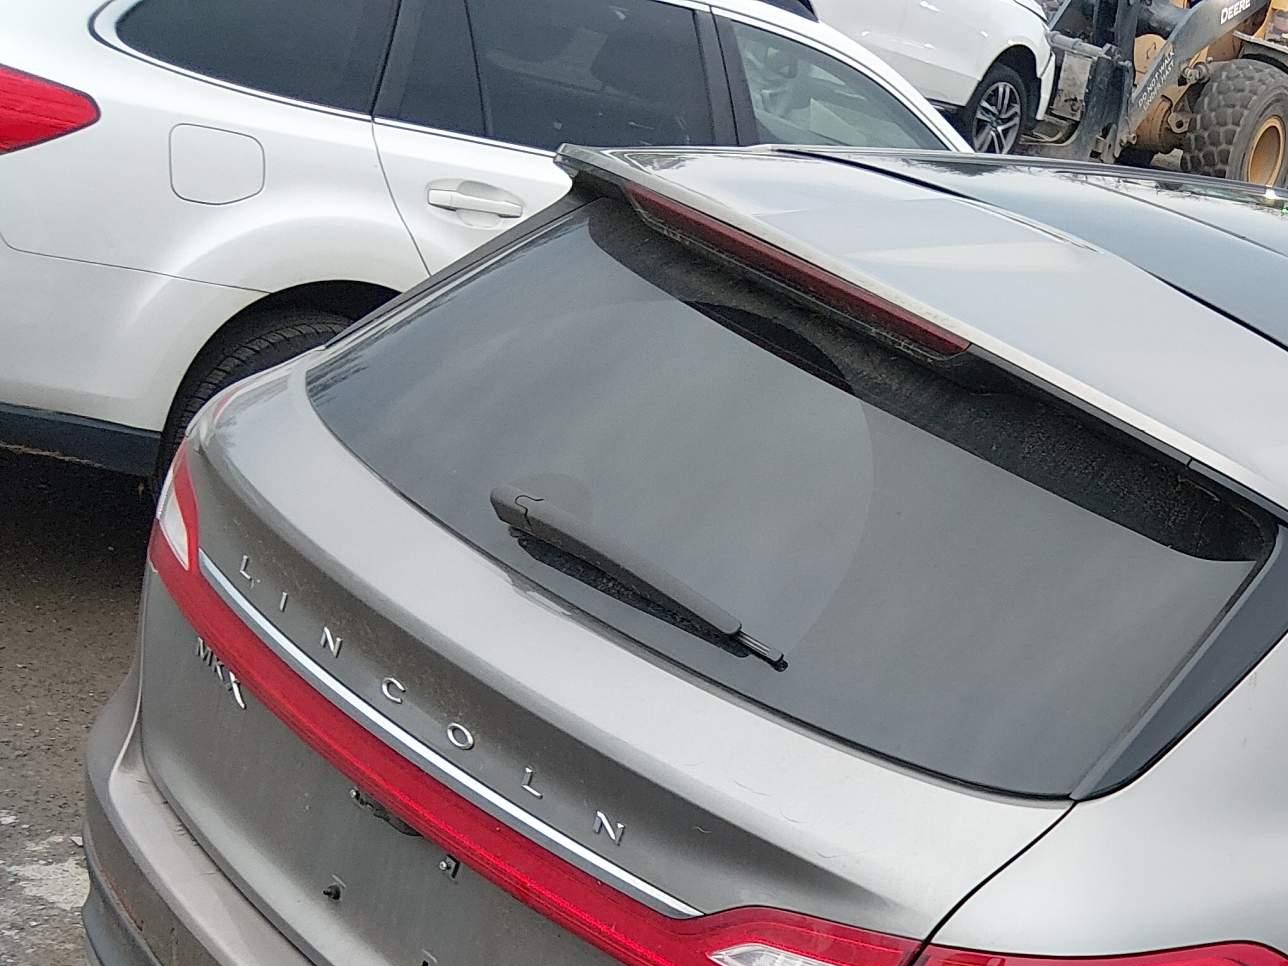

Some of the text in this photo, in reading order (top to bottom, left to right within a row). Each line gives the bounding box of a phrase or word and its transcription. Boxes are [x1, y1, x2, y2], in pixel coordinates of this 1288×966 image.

[1221, 0, 1250, 24] DEERE
[196, 636, 247, 709] MKX
[240, 555, 626, 846] LINCOLN
